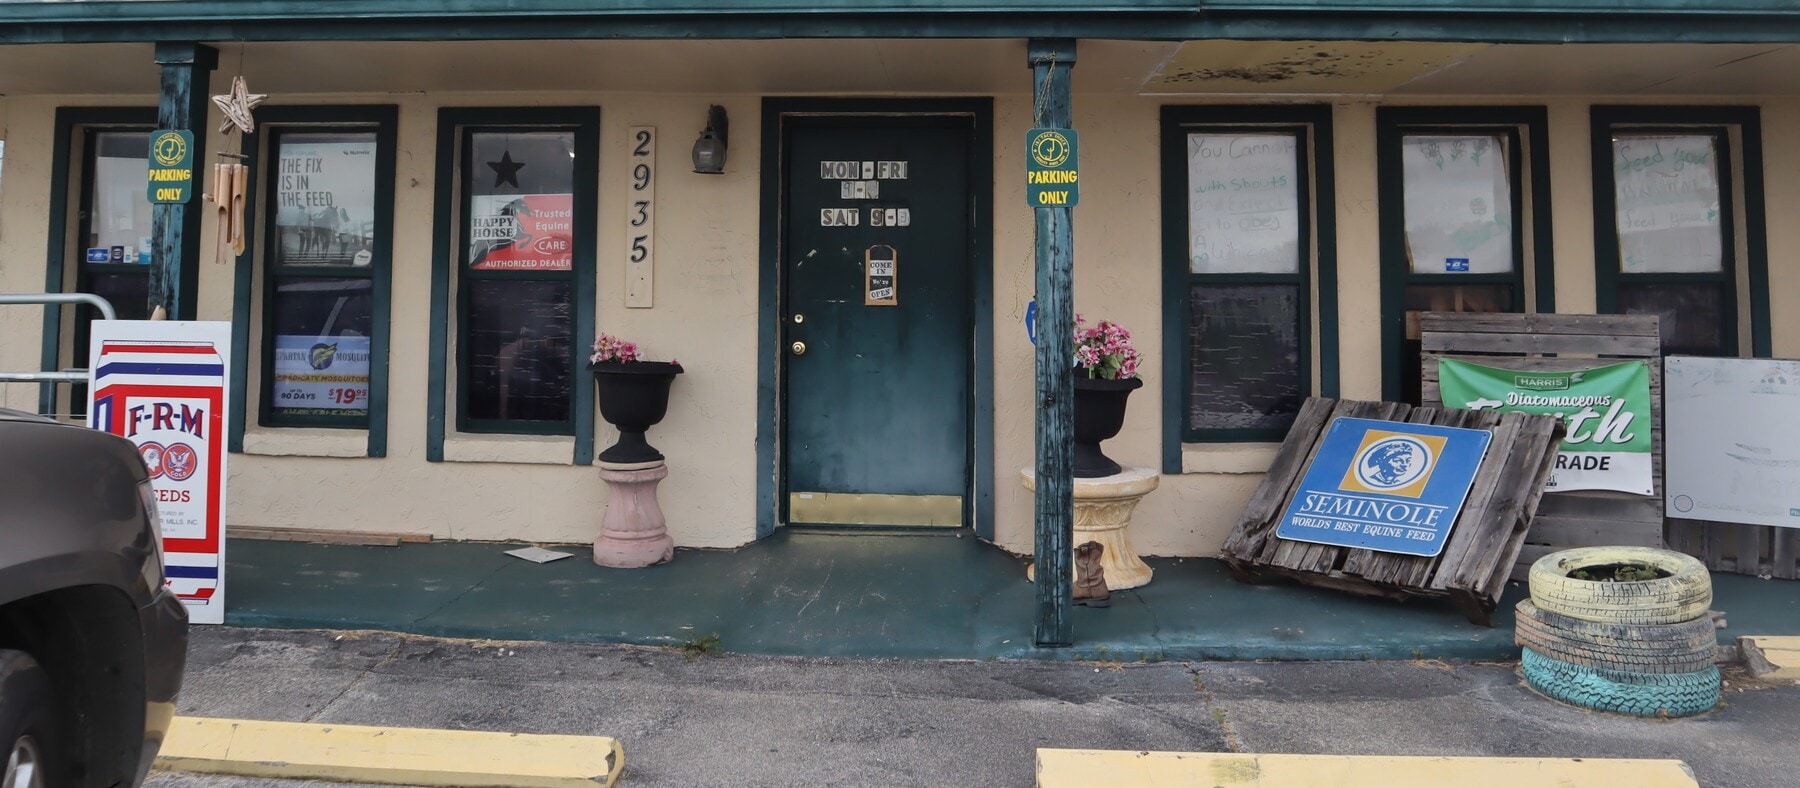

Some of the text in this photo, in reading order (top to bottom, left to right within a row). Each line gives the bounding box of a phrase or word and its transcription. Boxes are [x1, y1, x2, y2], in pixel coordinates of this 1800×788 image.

[1191, 137, 1223, 159] You
[281, 158, 323, 173] THE FIX
[1674, 147, 1709, 172] your
[149, 169, 191, 181] PARKING
[1028, 170, 1078, 184] PARKING
[282, 175, 309, 190] IS IN
[1194, 179, 1226, 193] with
[156, 188, 182, 201] ONLY
[281, 192, 333, 207] THE FEED
[631, 130, 652, 263] 2935
[1039, 191, 1068, 205] ONLY
[534, 209, 571, 219] Trusted
[822, 209, 859, 225] SAT
[473, 217, 515, 228] HAPPY
[536, 221, 569, 232] Equine
[473, 228, 515, 239] HORSE
[539, 241, 566, 251] CARE
[485, 259, 571, 269] AUTHORIZED DEALER
[871, 288, 891, 299] OPEN
[1520, 378, 1562, 386] HARRIS
[1506, 391, 1610, 408] Diatomaceous
[127, 402, 205, 440] F-R-M
[1555, 454, 1611, 471] RADE
[1300, 493, 1443, 528] SEMINOLE
[1291, 516, 1436, 542] WORLD'S BEST EQUINE FEED
